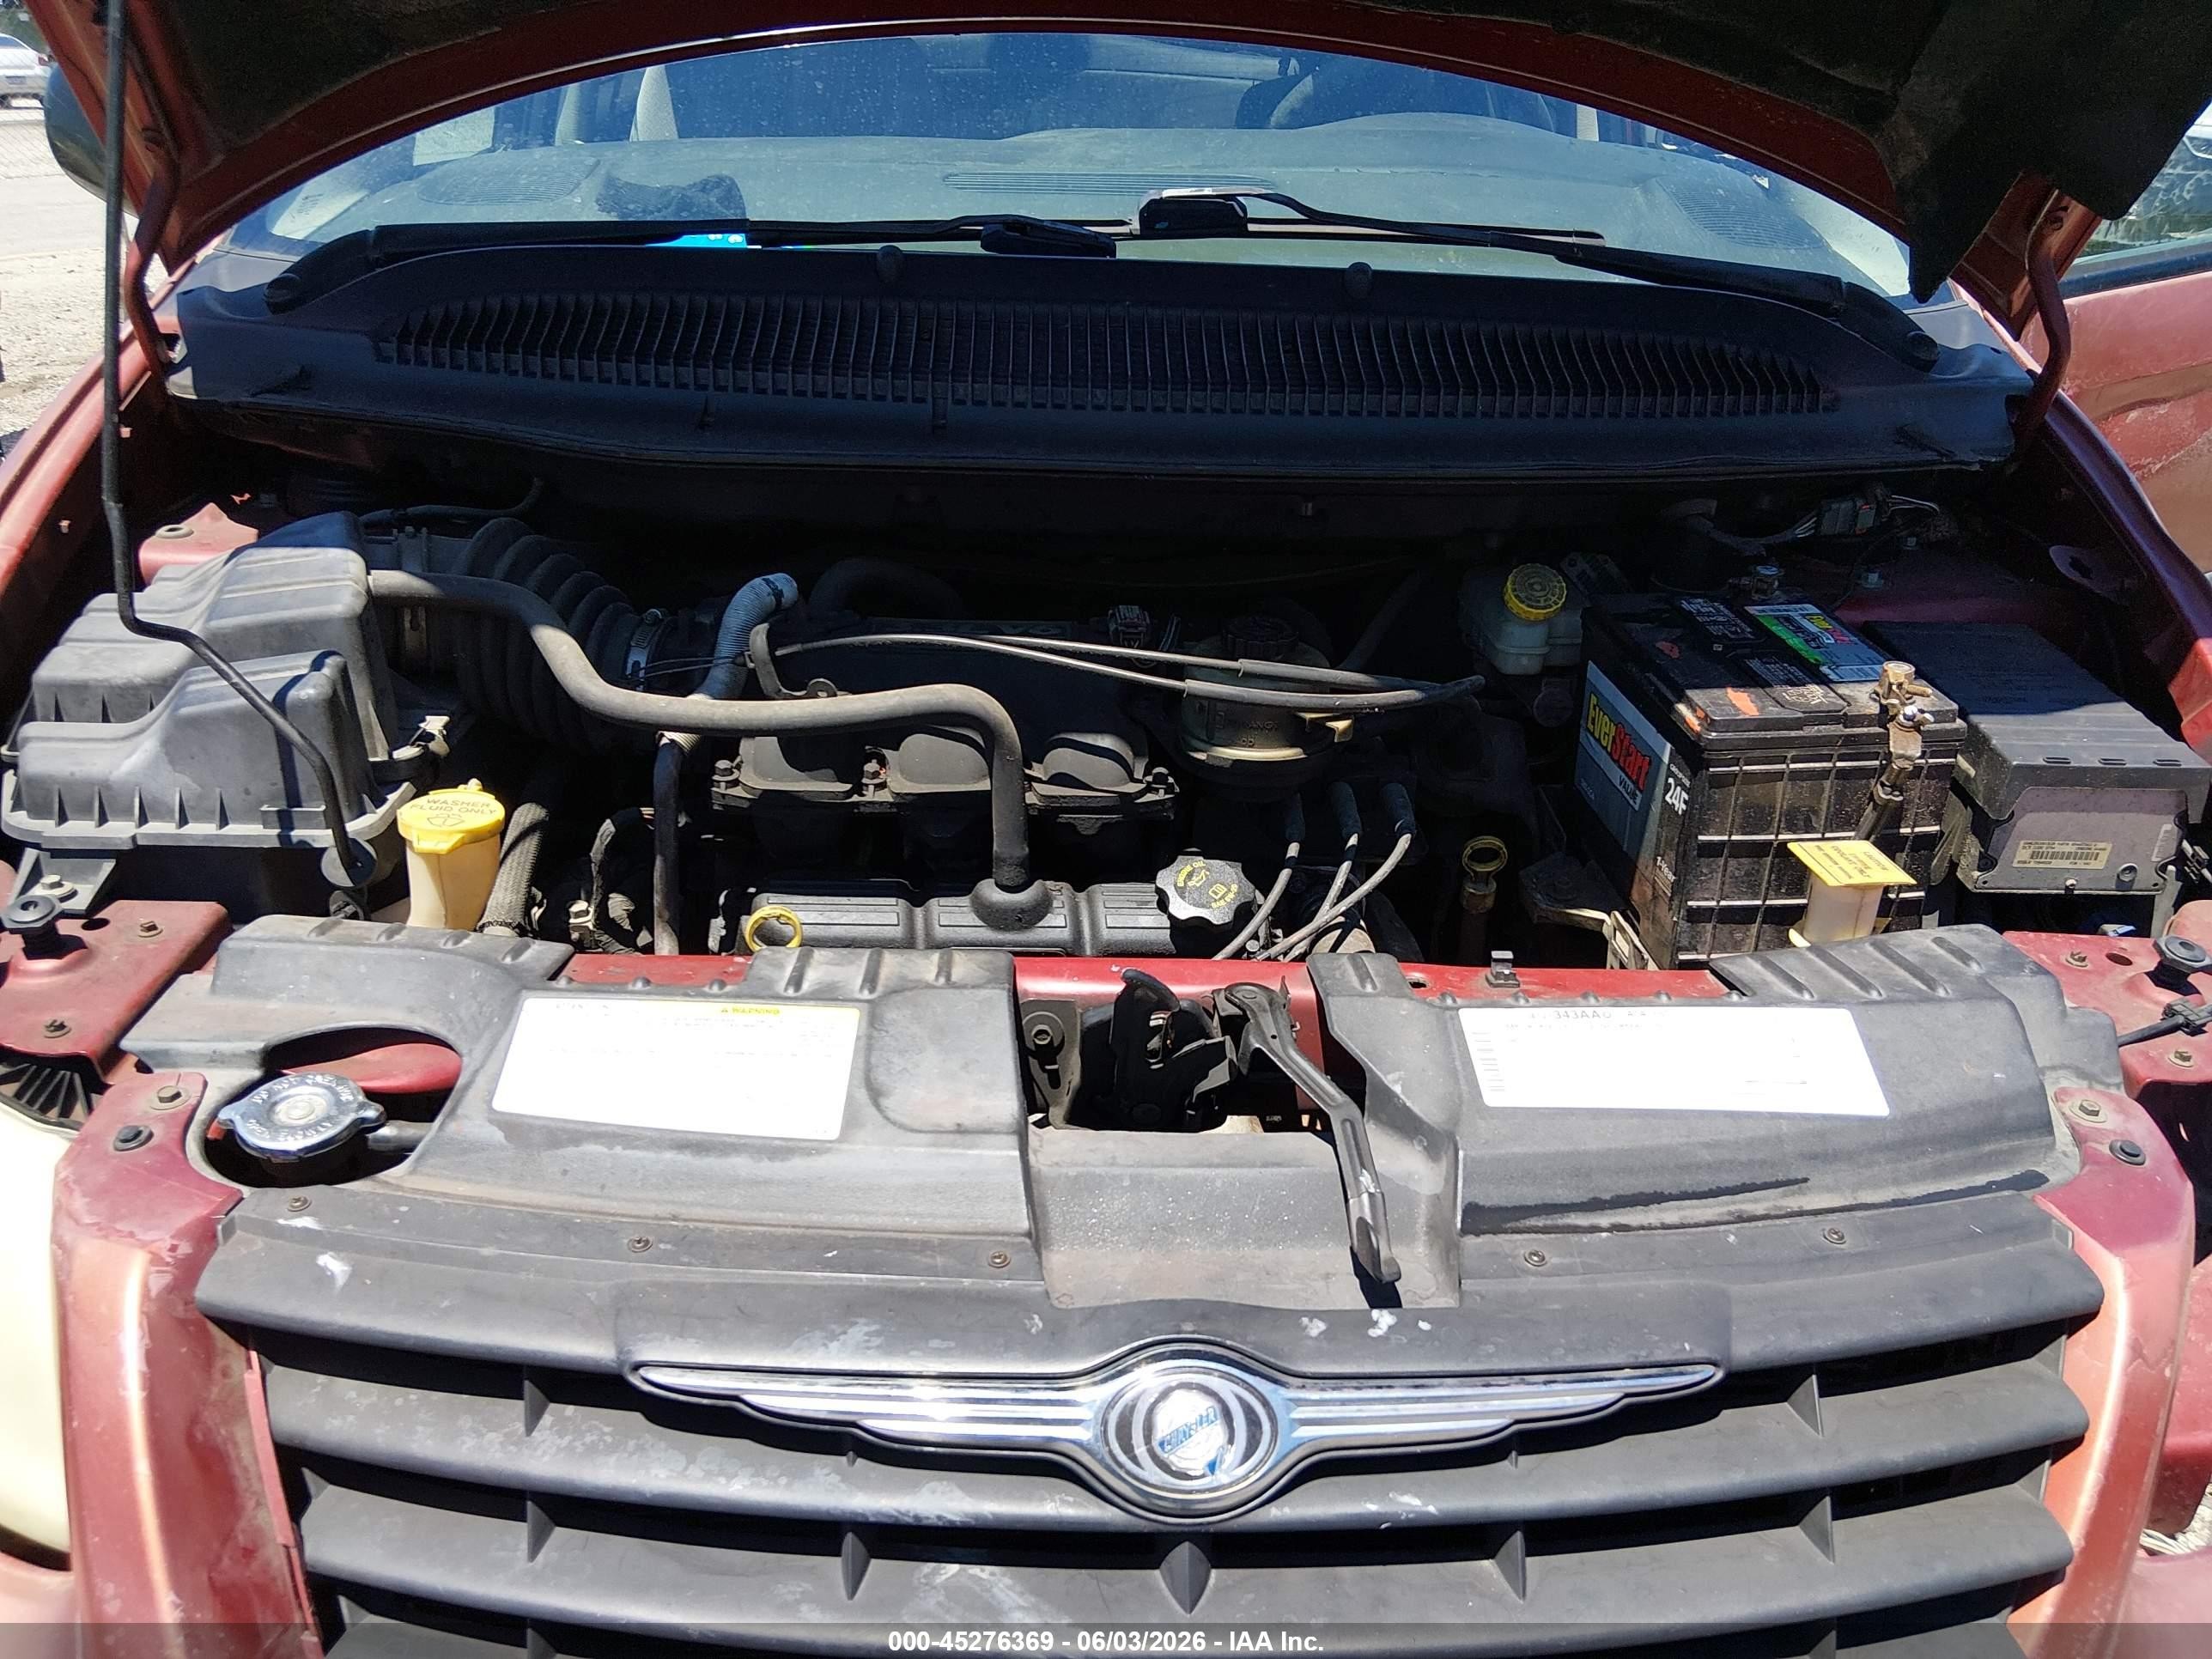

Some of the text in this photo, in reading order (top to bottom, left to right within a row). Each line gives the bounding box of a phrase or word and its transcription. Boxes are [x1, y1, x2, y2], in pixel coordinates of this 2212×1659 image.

[1587, 692, 1651, 792] EverStart
[427, 798, 491, 808] WASHER
[1619, 775, 1639, 806] VALUE
[1665, 777, 1689, 816] 24F
[1656, 856, 1676, 883] 1-Year
